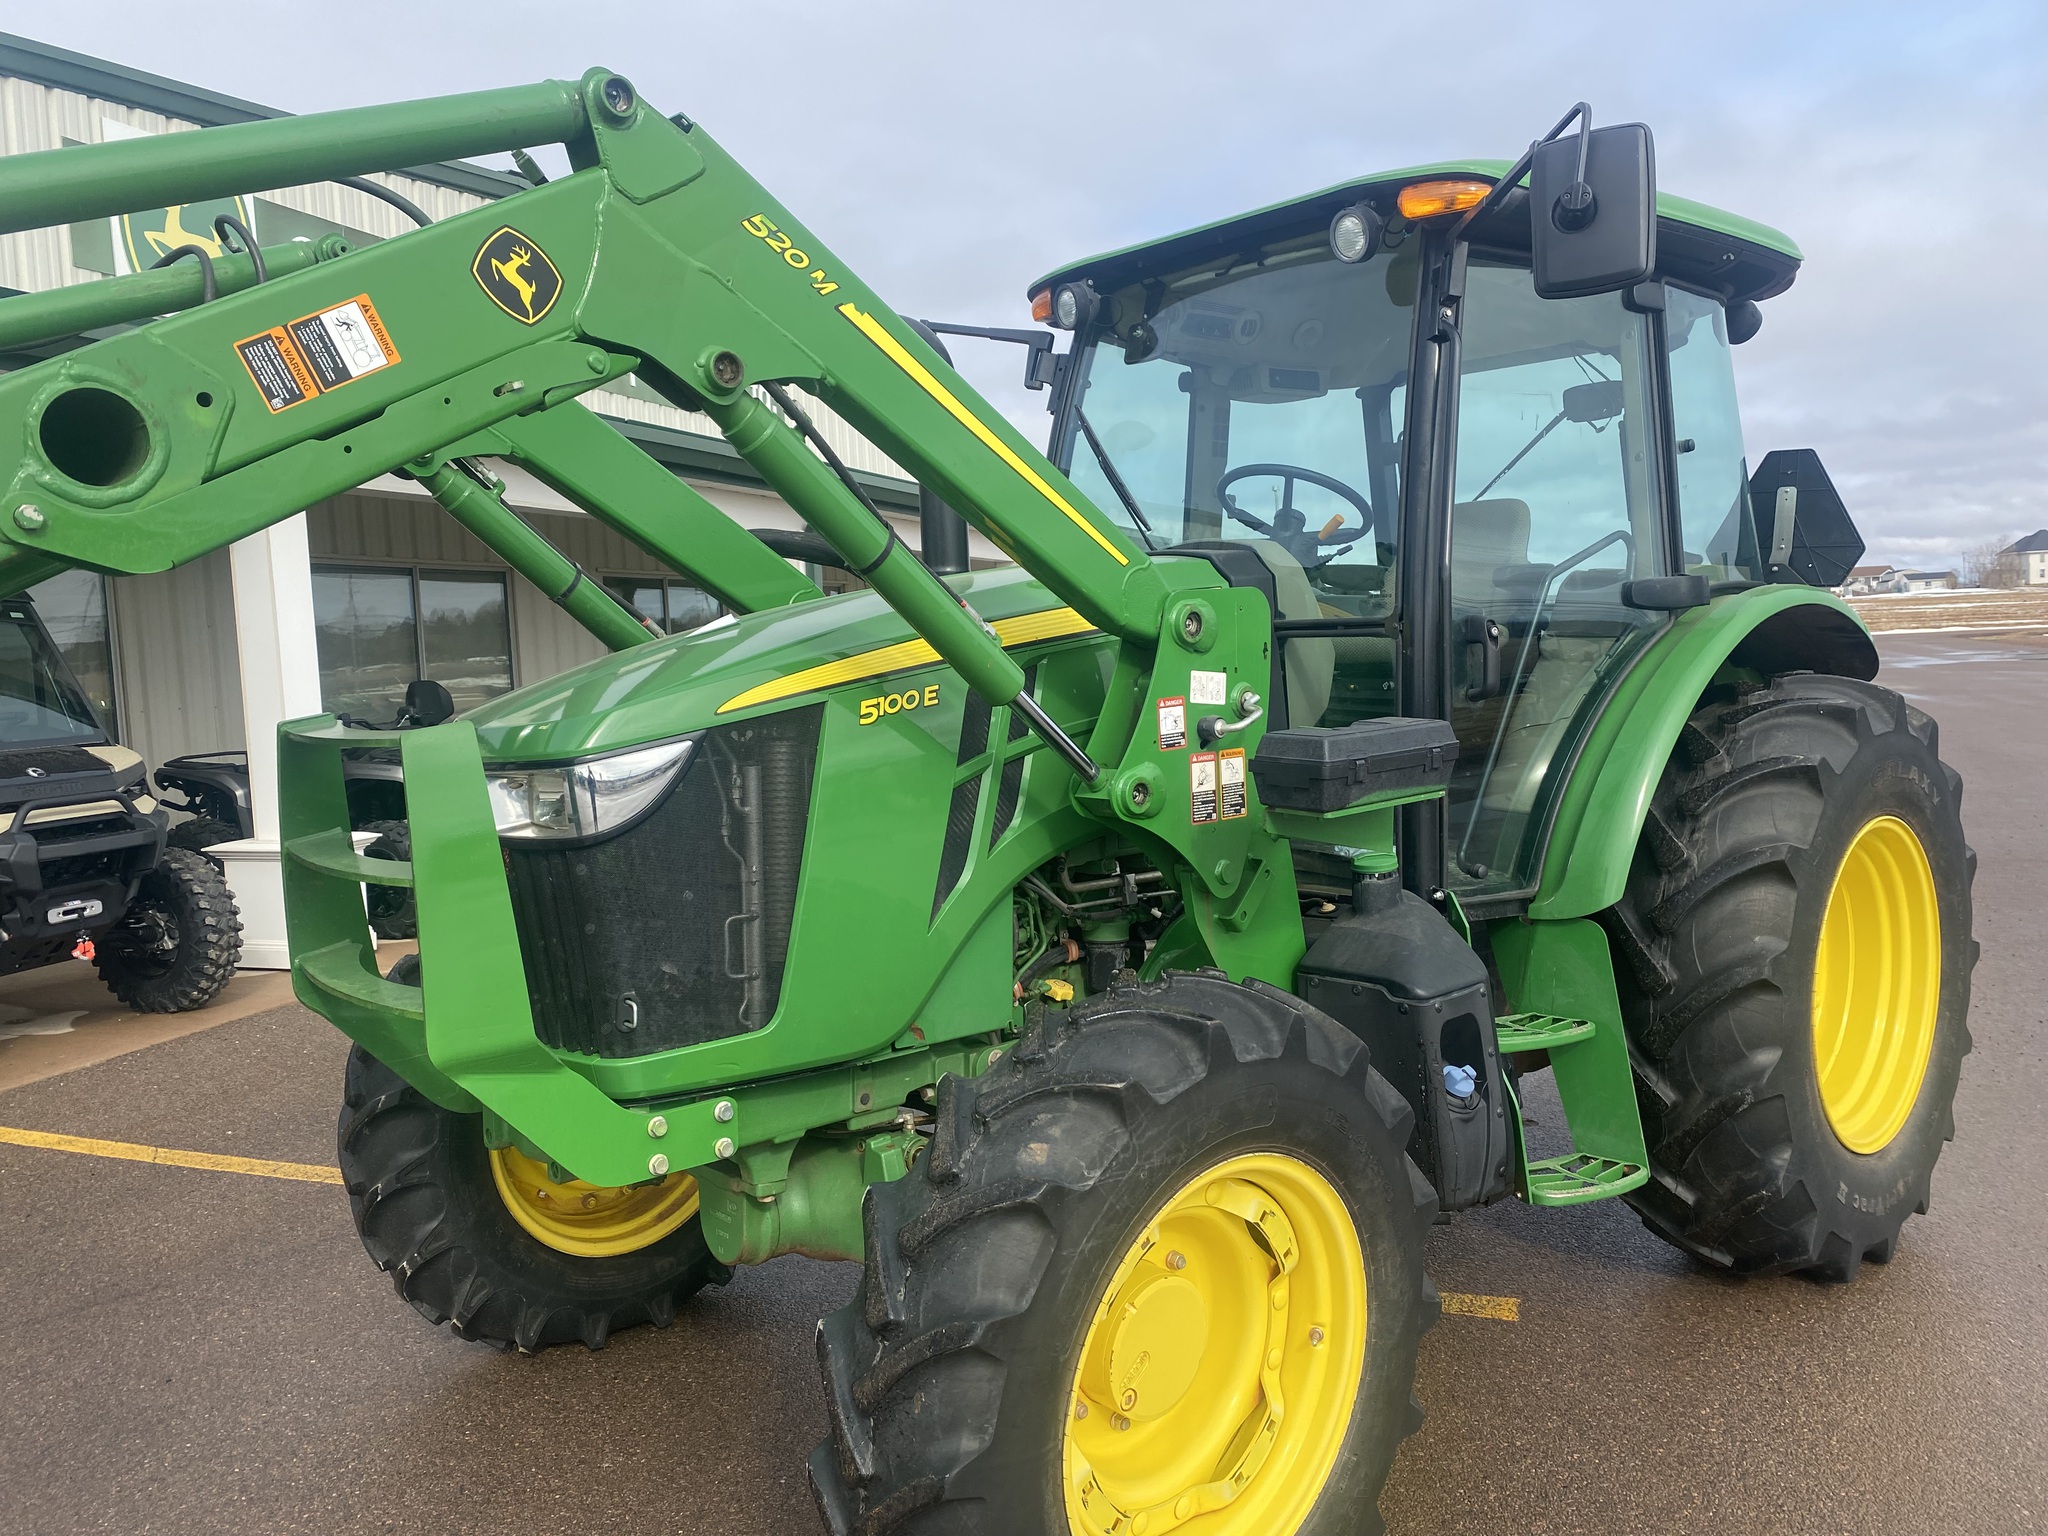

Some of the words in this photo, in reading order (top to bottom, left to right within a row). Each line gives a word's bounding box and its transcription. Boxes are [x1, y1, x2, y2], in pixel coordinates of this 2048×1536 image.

[741, 212, 810, 269] 520
[809, 269, 840, 296] M
[367, 313, 394, 357] WARNING
[284, 347, 311, 392] WARNING
[859, 687, 920, 726] 5100
[923, 684, 940, 709] E
[1872, 760, 1941, 807] GALAXY
